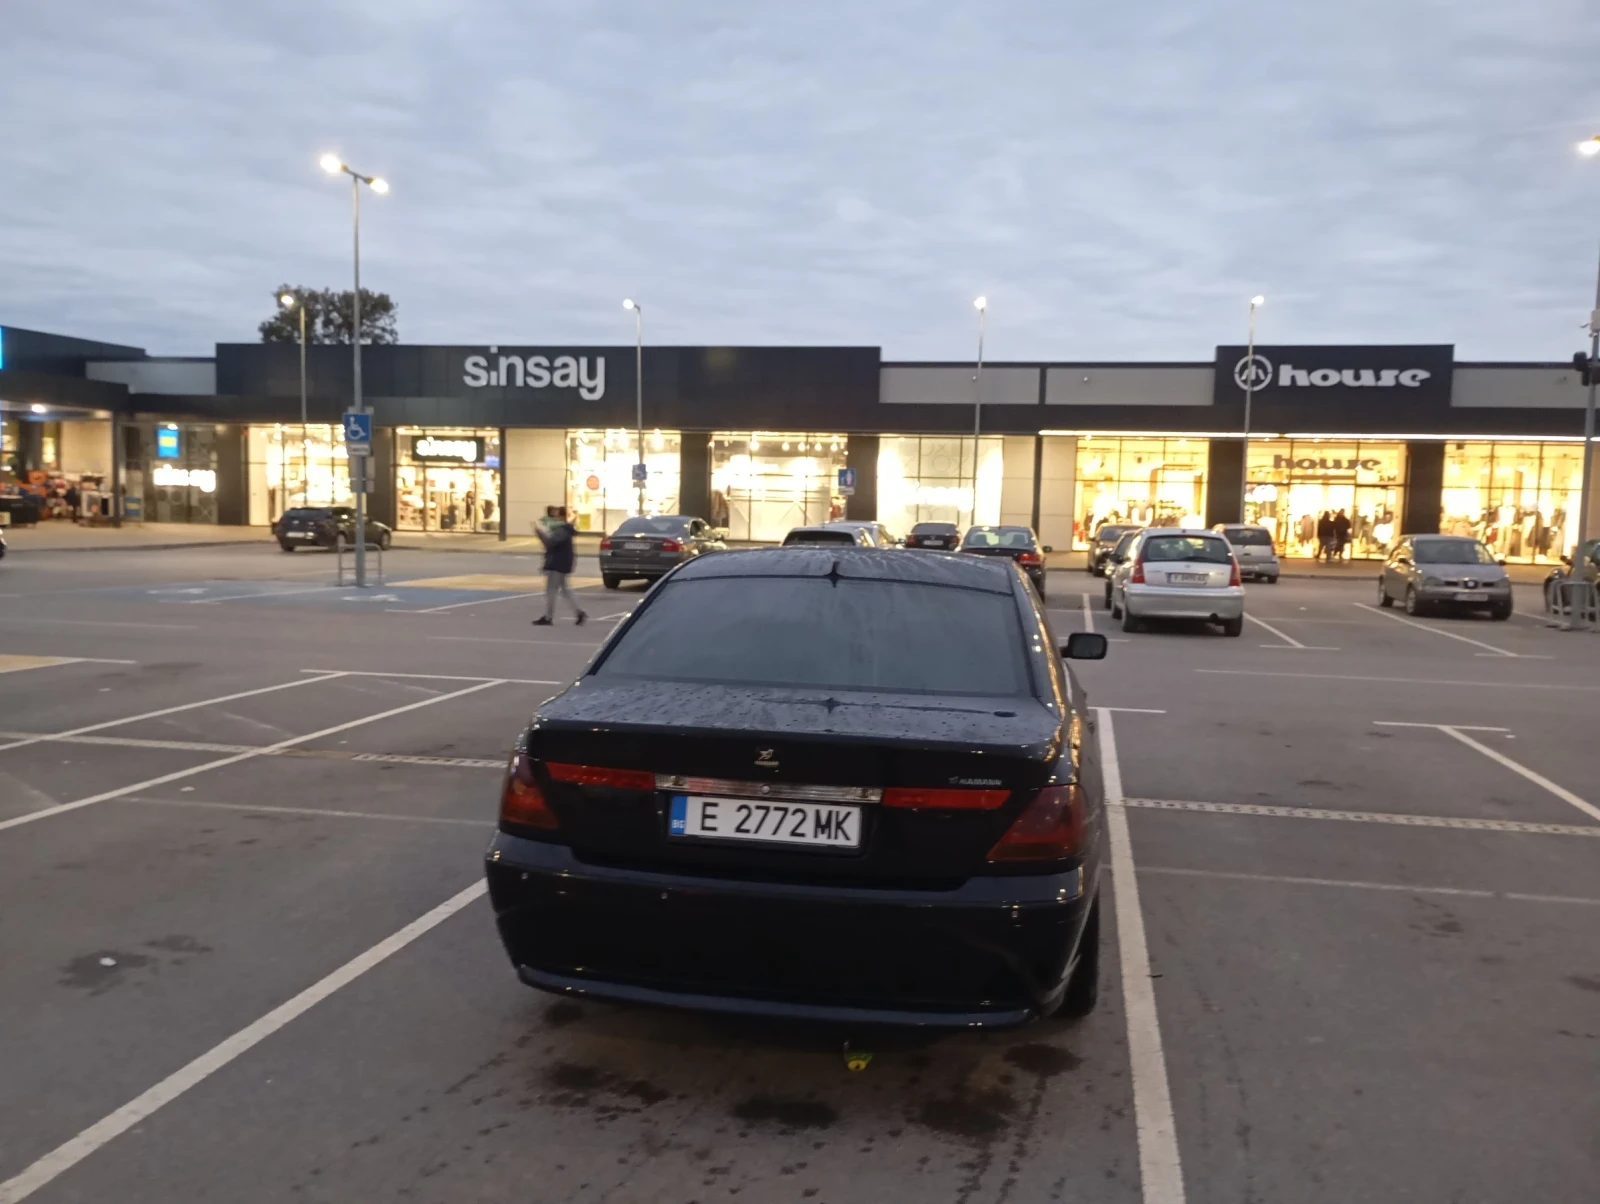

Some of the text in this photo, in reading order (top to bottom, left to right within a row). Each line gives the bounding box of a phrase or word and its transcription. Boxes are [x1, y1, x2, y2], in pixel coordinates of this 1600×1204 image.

[463, 346, 605, 400] sinsay
[1278, 364, 1431, 388] house
[1273, 454, 1382, 471] house
[701, 801, 852, 841] E 2772 MK
